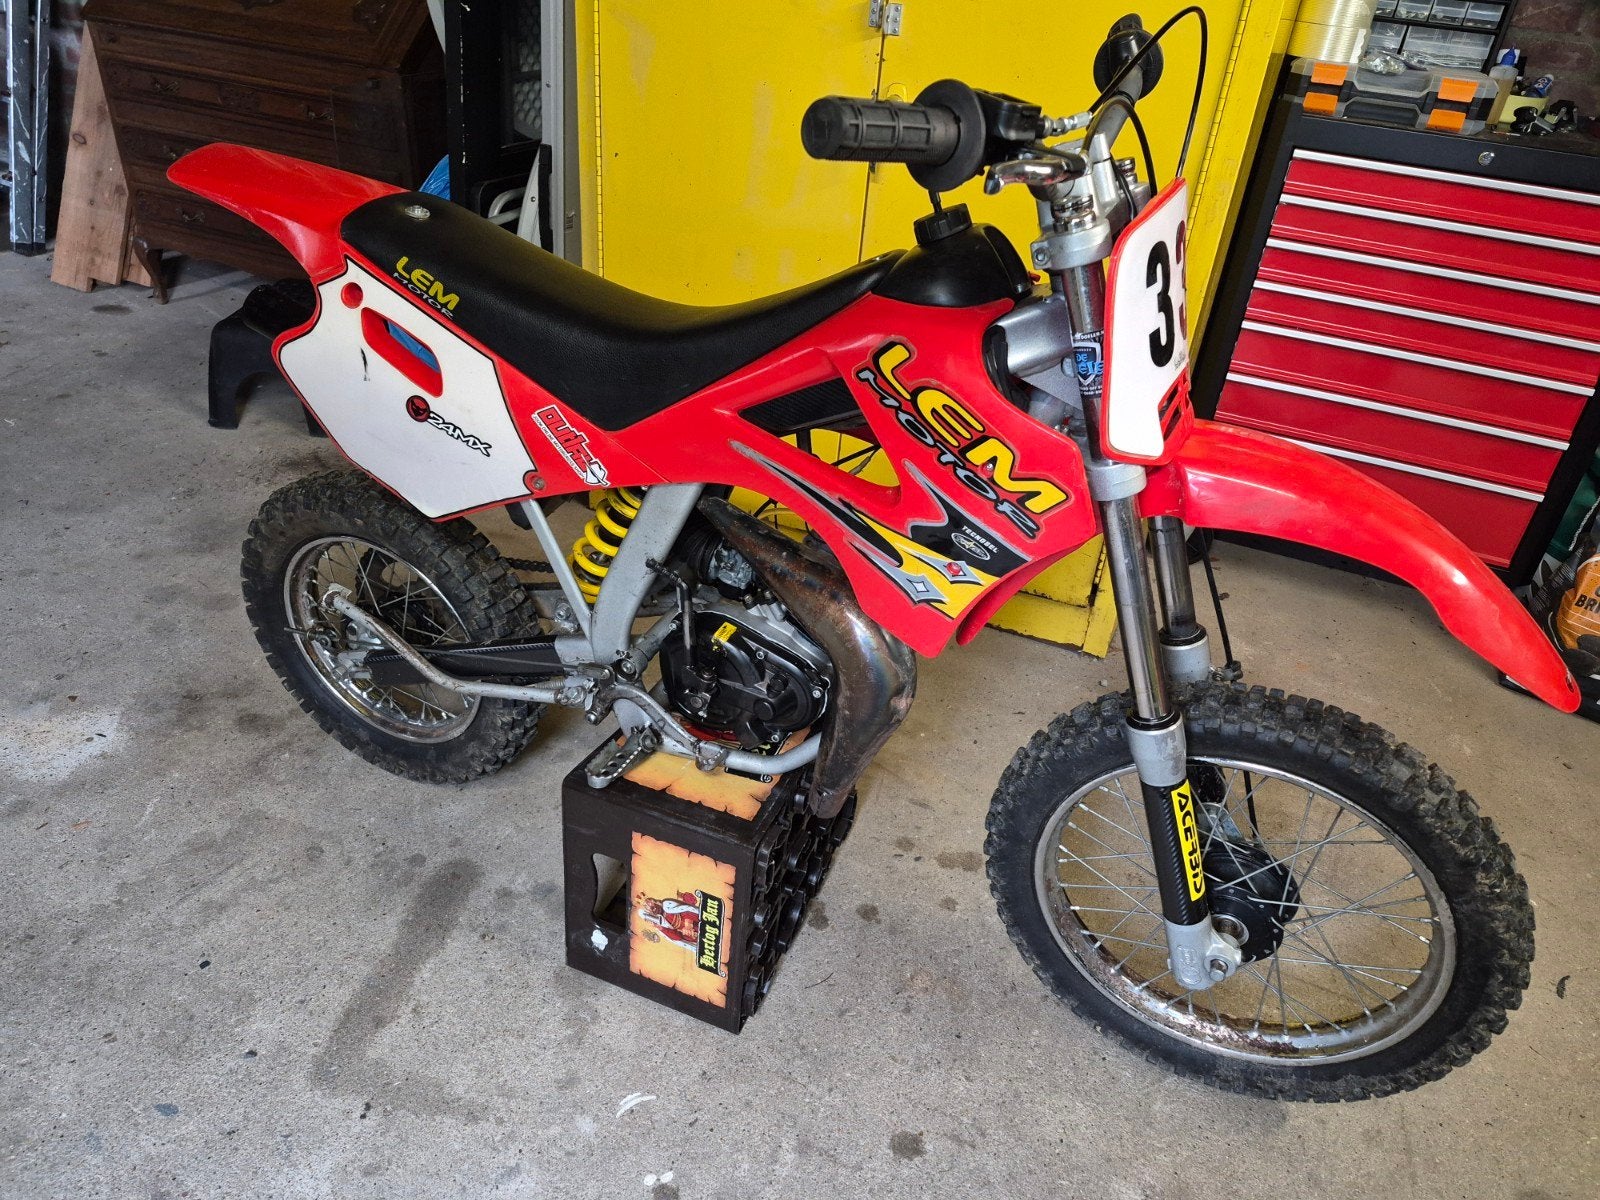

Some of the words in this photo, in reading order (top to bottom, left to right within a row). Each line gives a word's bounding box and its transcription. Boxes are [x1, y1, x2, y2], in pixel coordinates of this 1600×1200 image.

[393, 272, 454, 320] MOTOR
[396, 256, 460, 311] LEM
[427, 410, 492, 457] 24MX
[873, 341, 1069, 515] LEM
[855, 367, 1041, 540] MOTOR
[961, 525, 999, 553] TECNOBEL
[702, 898, 720, 926] Jan
[700, 924, 720, 969] Hertog
